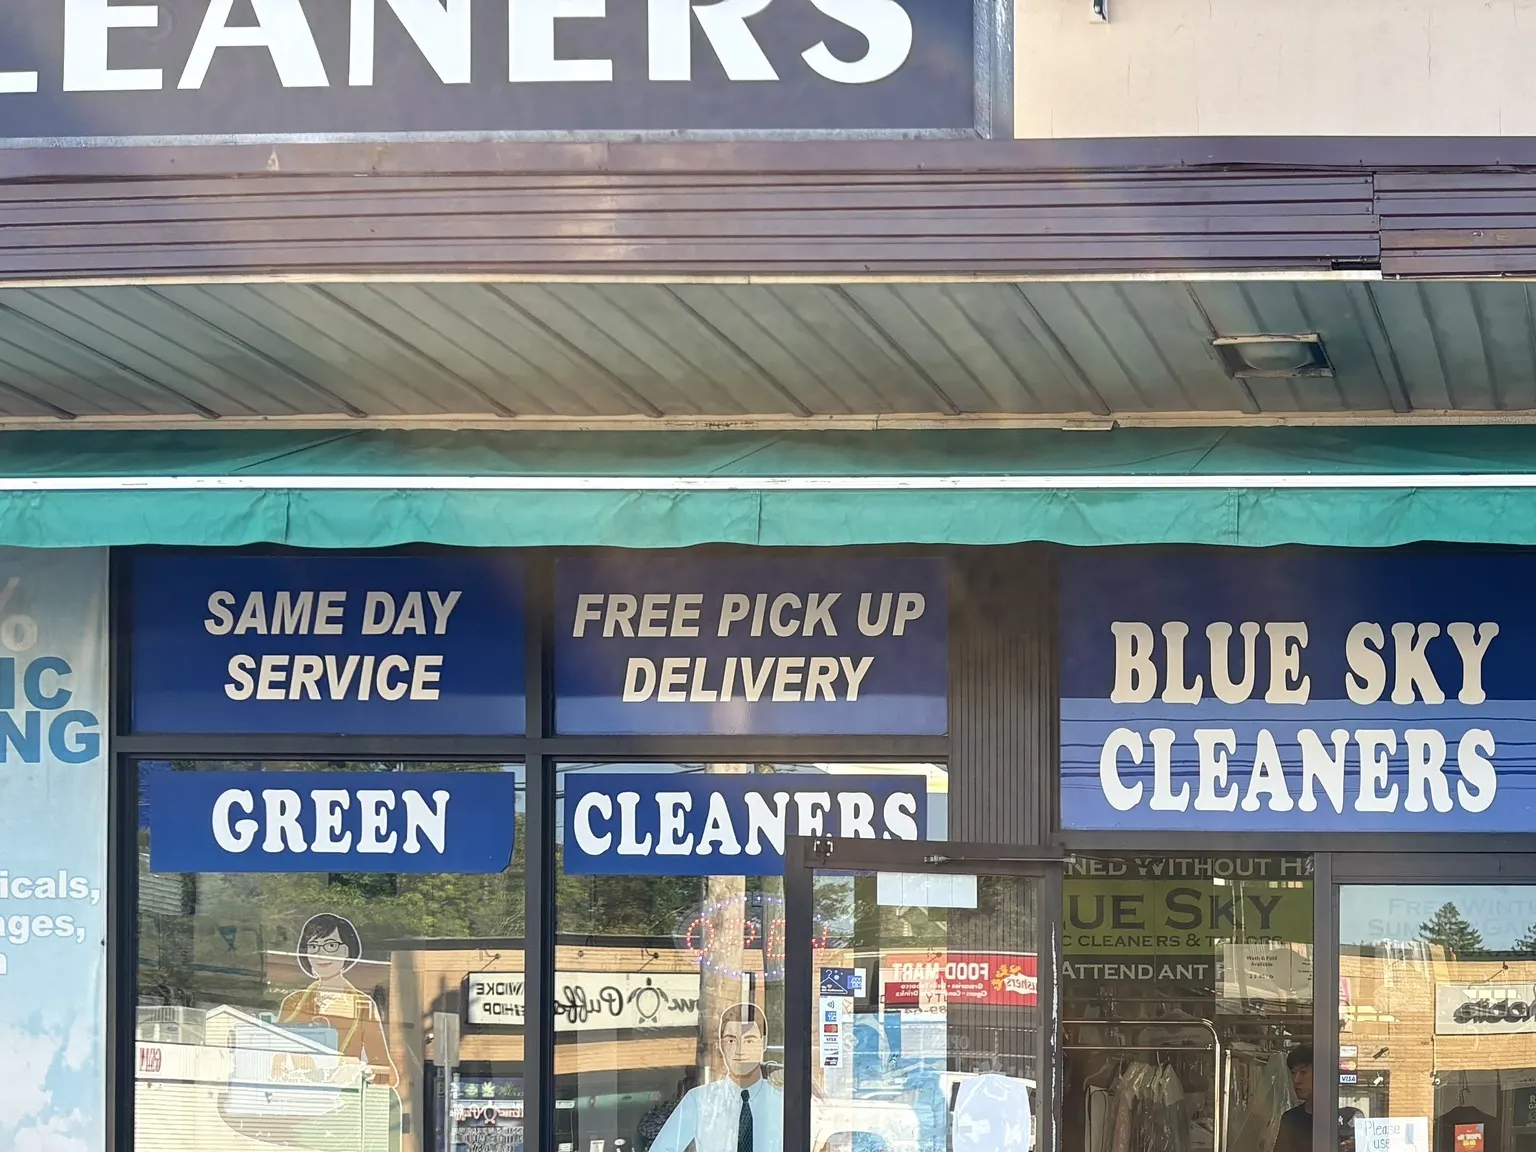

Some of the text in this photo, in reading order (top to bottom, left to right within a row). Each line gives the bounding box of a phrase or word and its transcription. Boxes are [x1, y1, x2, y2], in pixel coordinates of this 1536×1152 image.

[0, 0, 913, 93] EANERS
[203, 590, 463, 635] SAME DAY
[572, 592, 927, 638] FREE PICK UP
[223, 654, 444, 701] SERVICE
[622, 656, 875, 703] DELIVERY
[1110, 620, 1500, 705] BLUE SKY
[1099, 727, 1498, 814] CLEANERS
[211, 787, 451, 855] GREEN
[572, 790, 919, 856] CLEANERS
[1137, 858, 1272, 876] WITHOUT
[1063, 893, 1146, 931] UE
[1077, 935, 1181, 947] CLEANERS
[1185, 933, 1201, 948] &
[1364, 1120, 1401, 1137] Please
